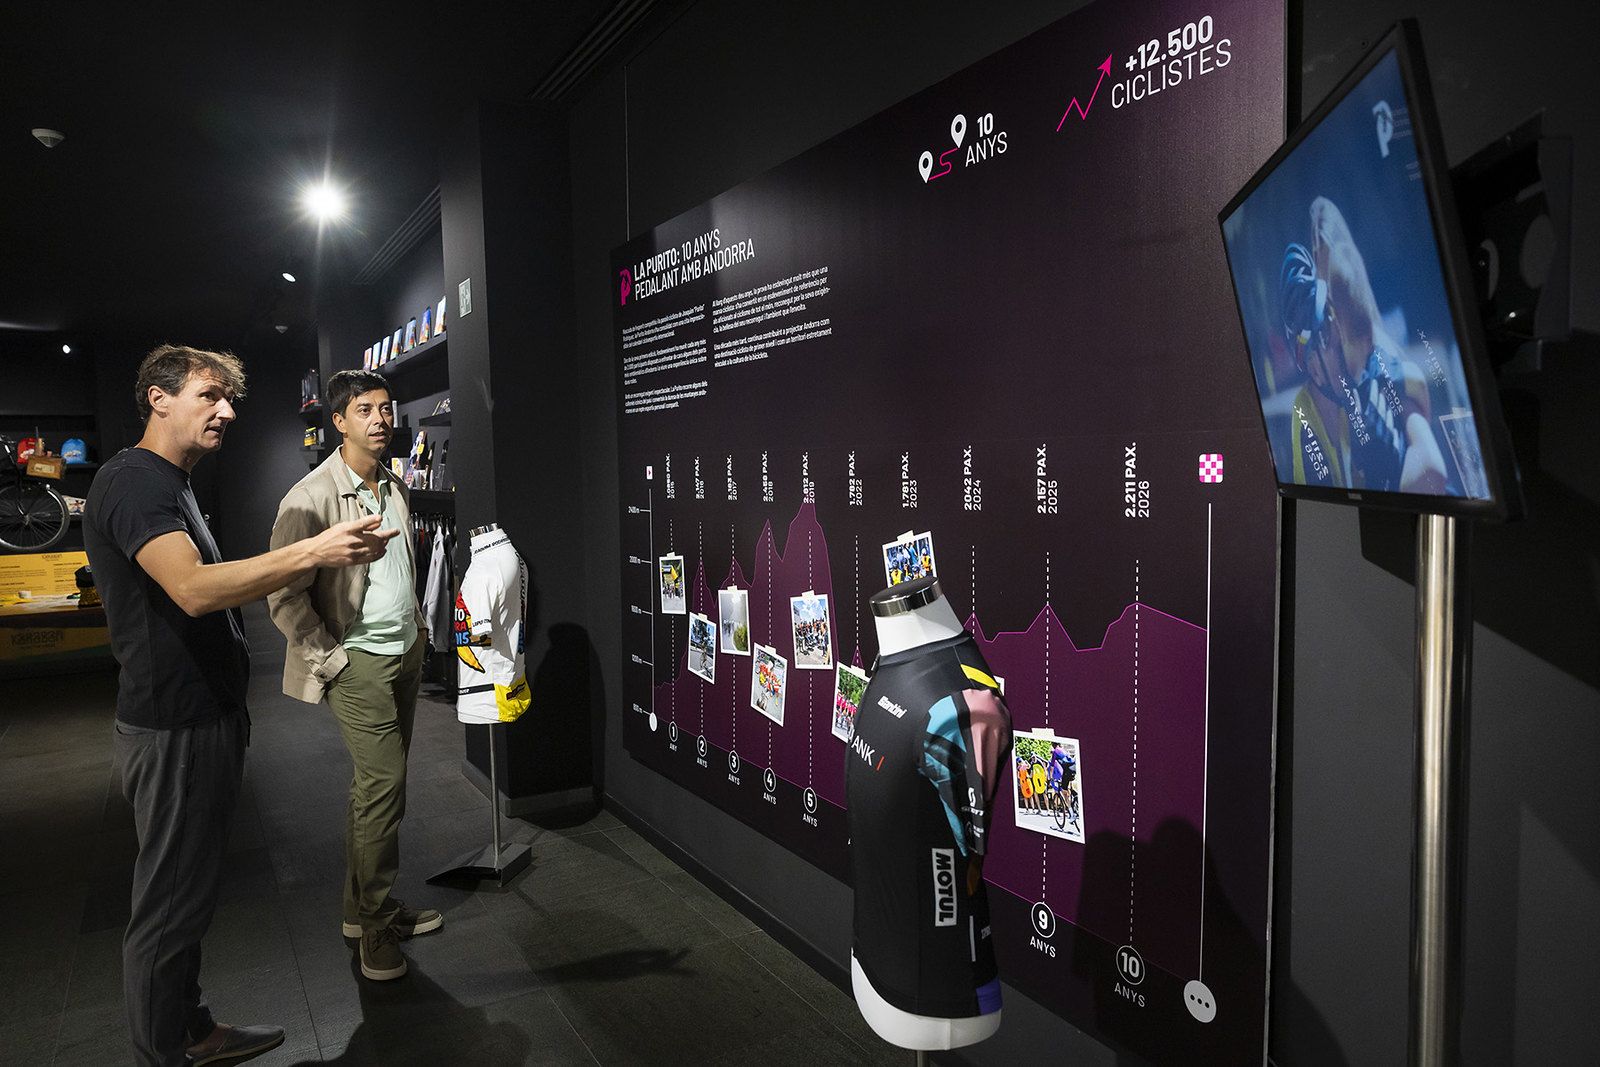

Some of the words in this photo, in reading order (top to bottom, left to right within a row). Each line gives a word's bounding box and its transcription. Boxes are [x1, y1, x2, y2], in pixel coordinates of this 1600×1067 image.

[1125, 15, 1213, 72] +12.500
[1111, 38, 1232, 109] CICLISTES
[977, 113, 994, 138] 10
[965, 131, 1008, 167] ANYS
[634, 261, 646, 282] LA
[646, 248, 680, 276] PURITO:
[682, 241, 692, 262] 10
[693, 228, 720, 258] ANYS
[635, 267, 680, 300] PEDALANT
[680, 260, 700, 284] AMB
[703, 238, 755, 276] ANDORRA
[964, 445, 972, 475] PAX.
[1037, 443, 1047, 476] PAX.
[1125, 442, 1137, 478] PAX.
[964, 478, 972, 511] 2042
[973, 479, 982, 511] 2024
[1037, 479, 1047, 514] 2.157
[1048, 480, 1058, 514] 2025
[1125, 481, 1136, 518] 2.211
[1138, 480, 1150, 518] 2026
[700, 740, 705, 752] 2
[732, 755, 737, 768] 3
[696, 757, 708, 768] ANYS
[728, 773, 740, 786] ANYS
[767, 773, 773, 787] 4
[763, 792, 777, 805] ANYS
[807, 793, 813, 807] 5
[803, 813, 818, 827] ANYS
[936, 852, 954, 922] MOTUL
[1039, 910, 1048, 930] 9
[1030, 936, 1056, 958] ANYS
[1121, 952, 1140, 978] 10
[1114, 982, 1145, 1007] ANYS
